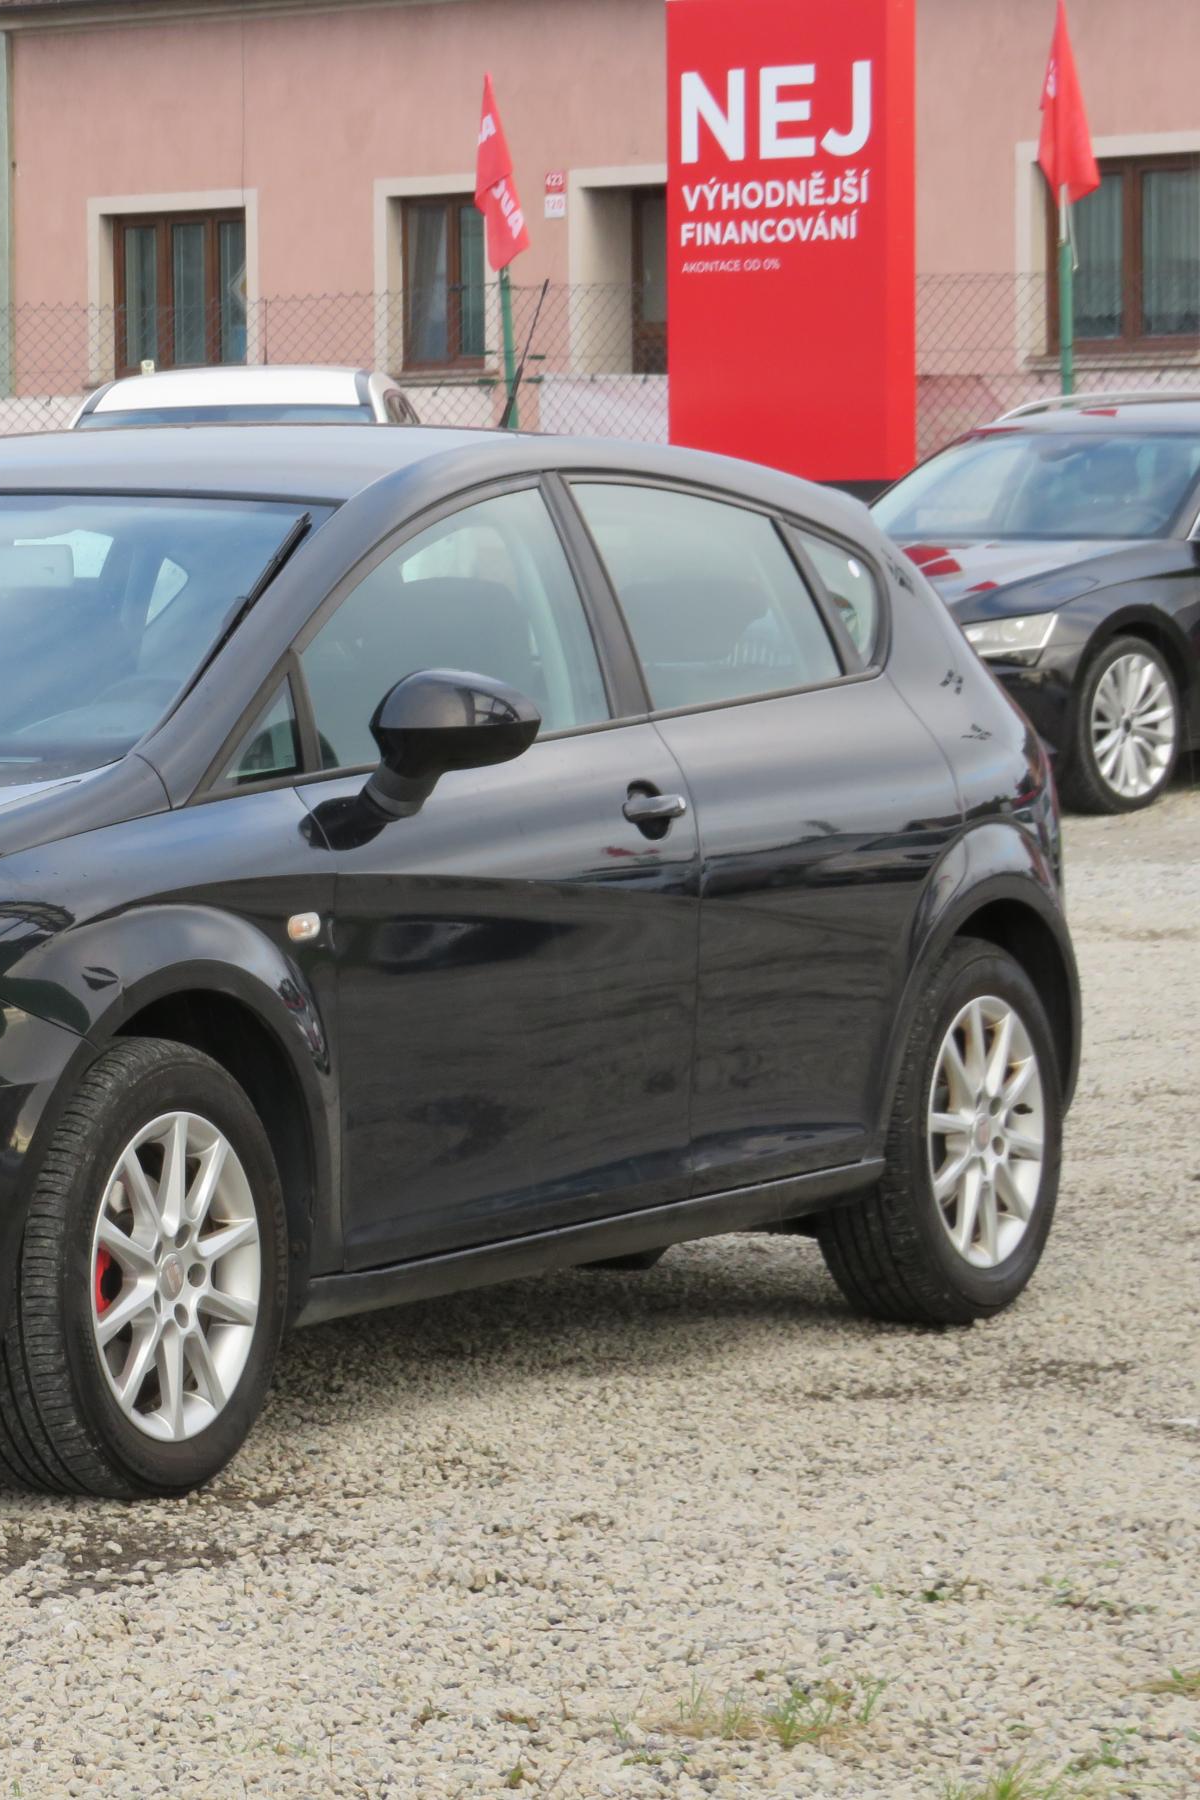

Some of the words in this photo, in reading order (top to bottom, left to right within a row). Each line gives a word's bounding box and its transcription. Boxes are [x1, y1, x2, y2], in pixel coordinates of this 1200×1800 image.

[680, 60, 873, 164] NEJ
[681, 168, 870, 213] VÝHODNĚJŠÍ
[680, 209, 858, 247] FINANCOVÁNÍ
